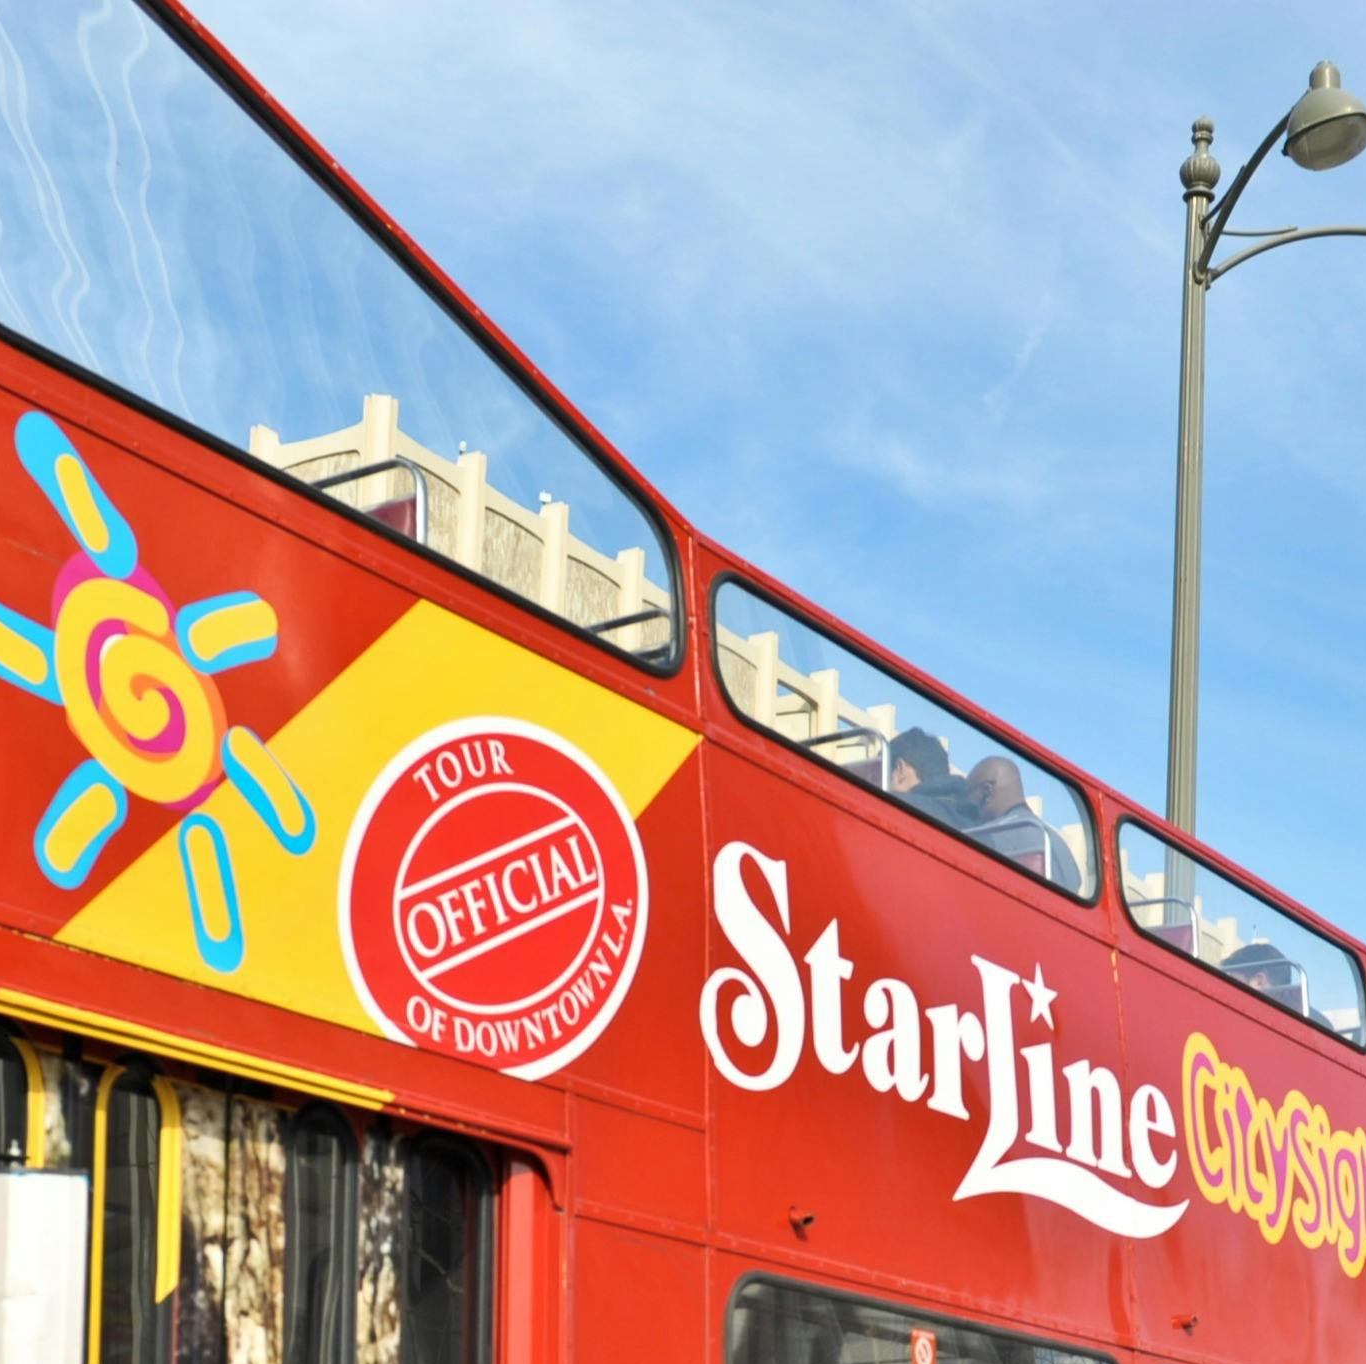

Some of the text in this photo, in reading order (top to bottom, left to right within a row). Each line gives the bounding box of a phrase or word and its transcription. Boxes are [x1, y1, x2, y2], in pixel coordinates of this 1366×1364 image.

[412, 738, 515, 804] TOUR
[406, 834, 598, 959] OFFICIAL
[406, 897, 634, 1058] OF DOWNTOWN L.A.
